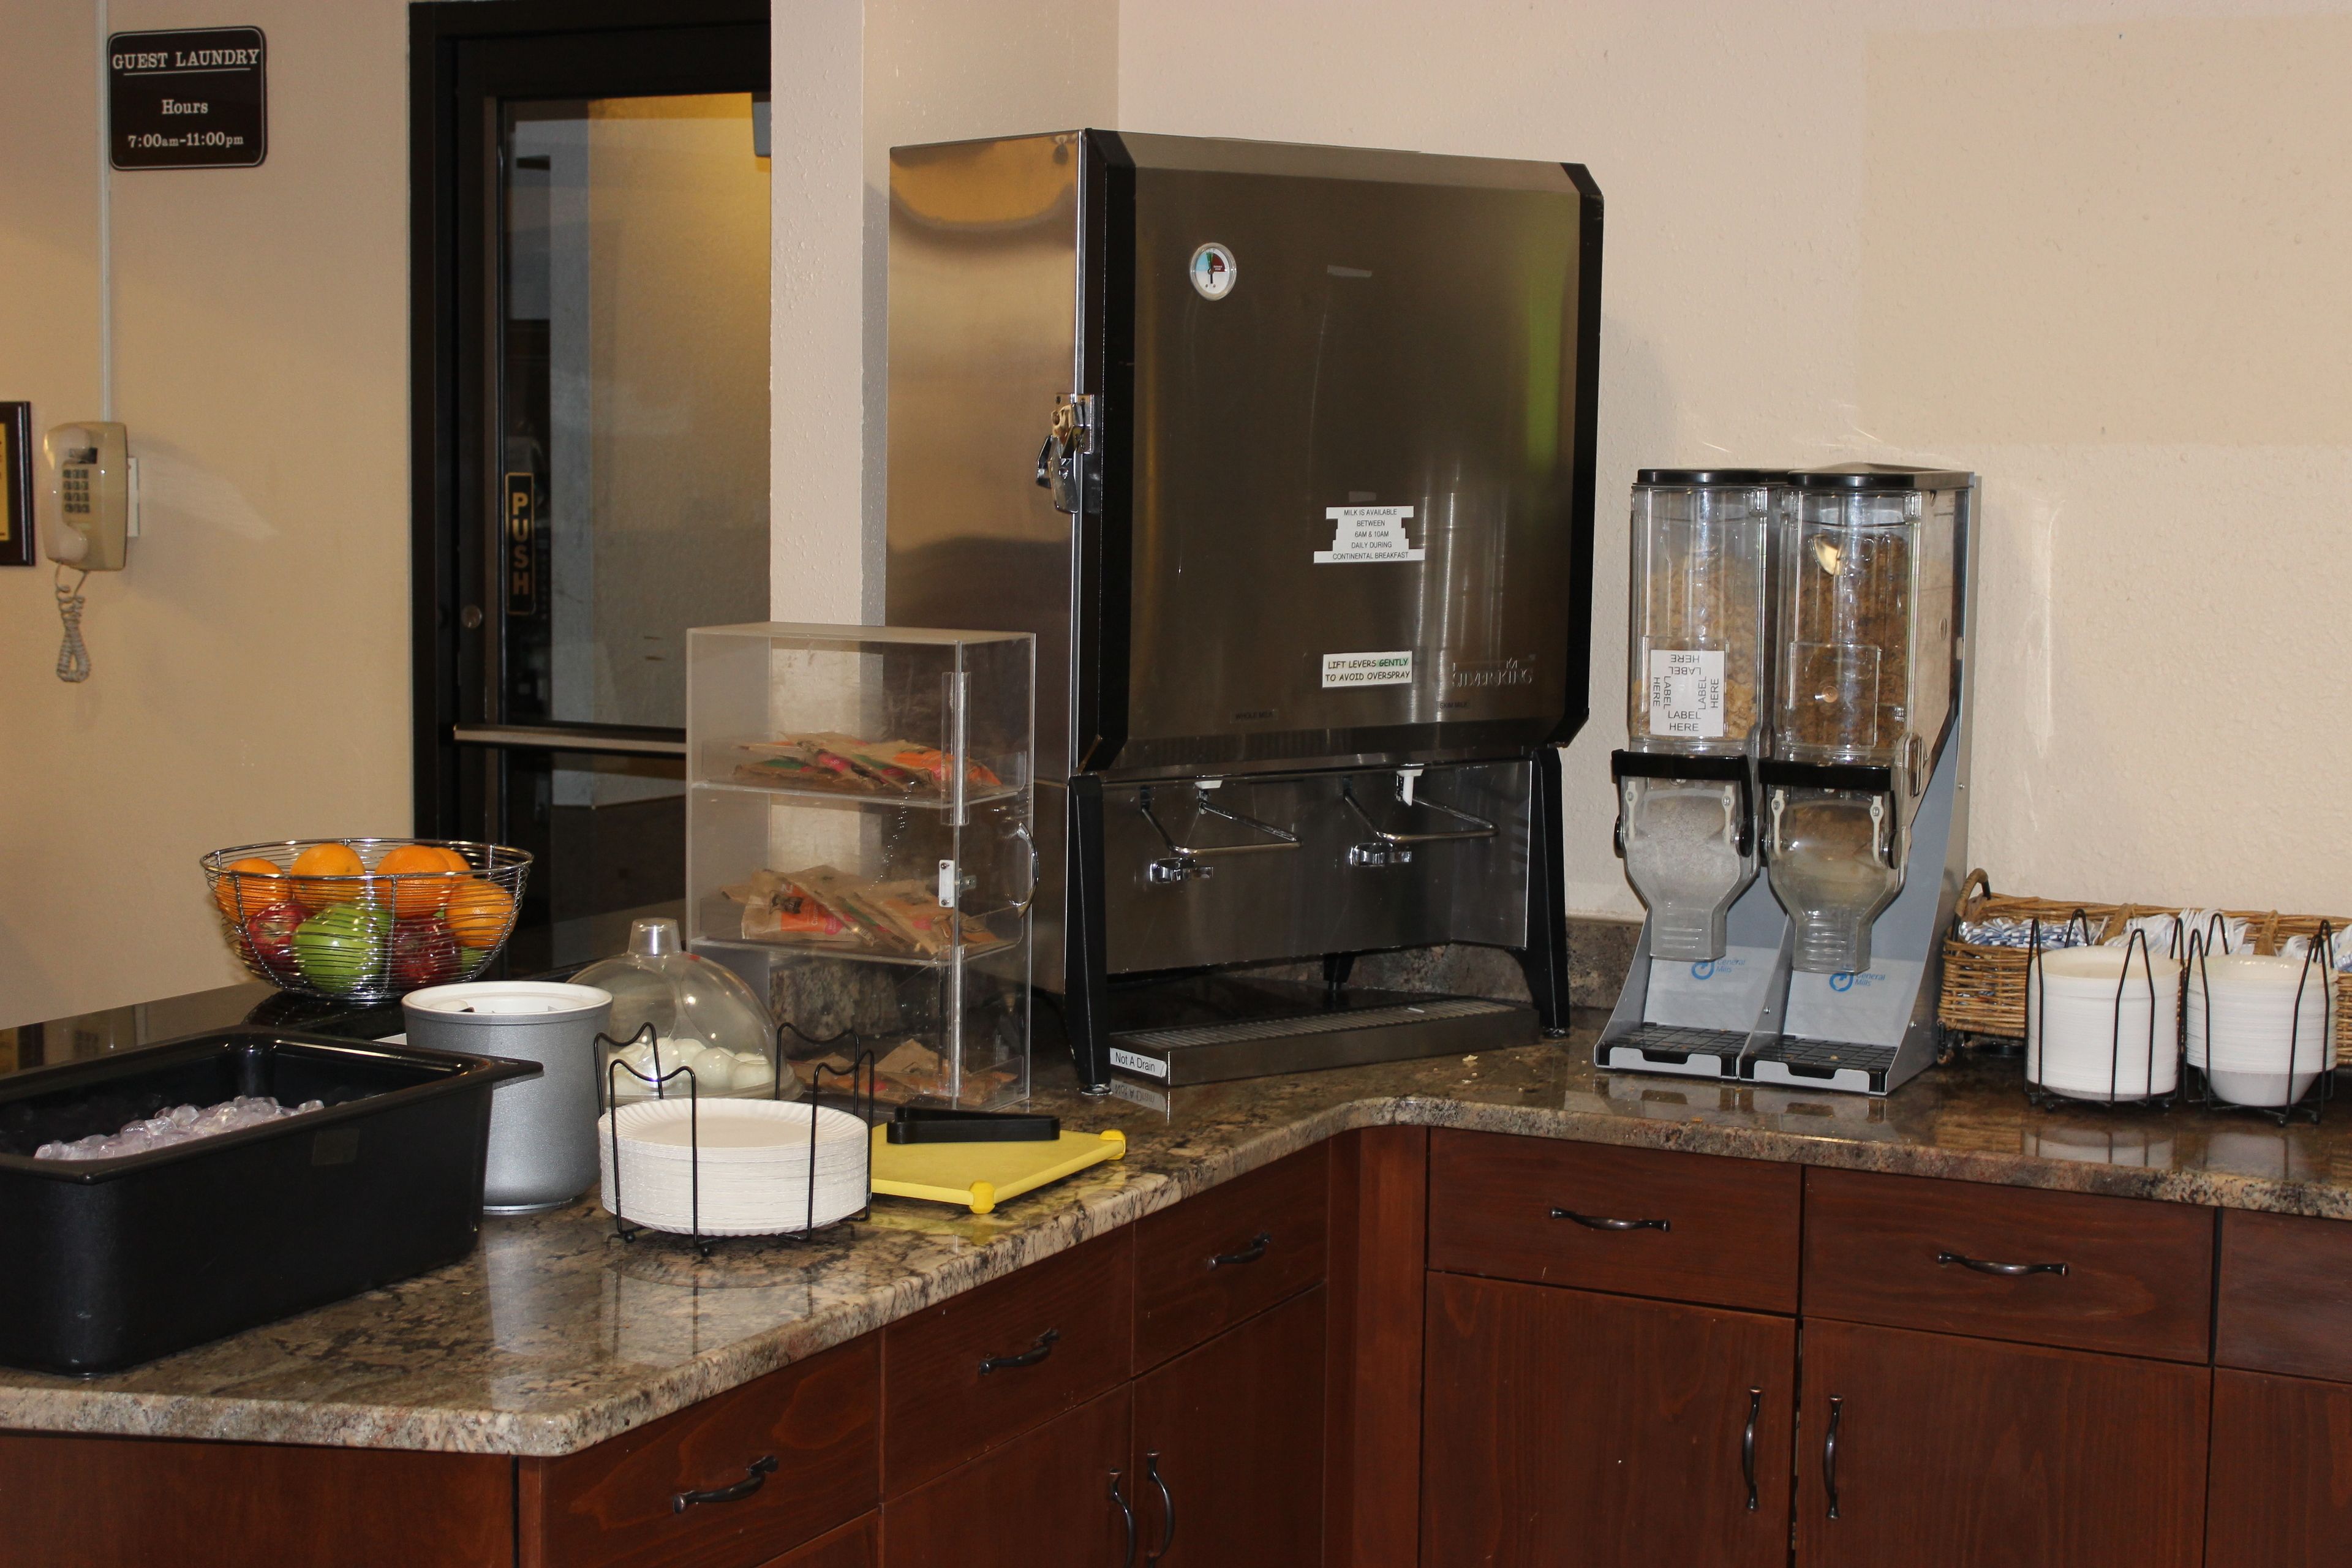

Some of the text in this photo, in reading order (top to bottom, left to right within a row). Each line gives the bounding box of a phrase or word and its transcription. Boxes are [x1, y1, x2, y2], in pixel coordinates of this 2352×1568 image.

[113, 49, 260, 69] GUEST LAUNDRY
[162, 99, 208, 115] Hours
[128, 132, 244, 148] 7:00am-11:00pm
[512, 492, 529, 595] PUSH
[1349, 660, 1376, 668] LEVERS
[1671, 654, 1700, 663] HERE
[1367, 671, 1411, 680] OVERSPRAY
[1668, 666, 1702, 675] LABEL
[1698, 676, 1706, 710] LABEL
[1670, 723, 1699, 731] HERE
[1115, 1052, 1155, 1072] Not A Drain
